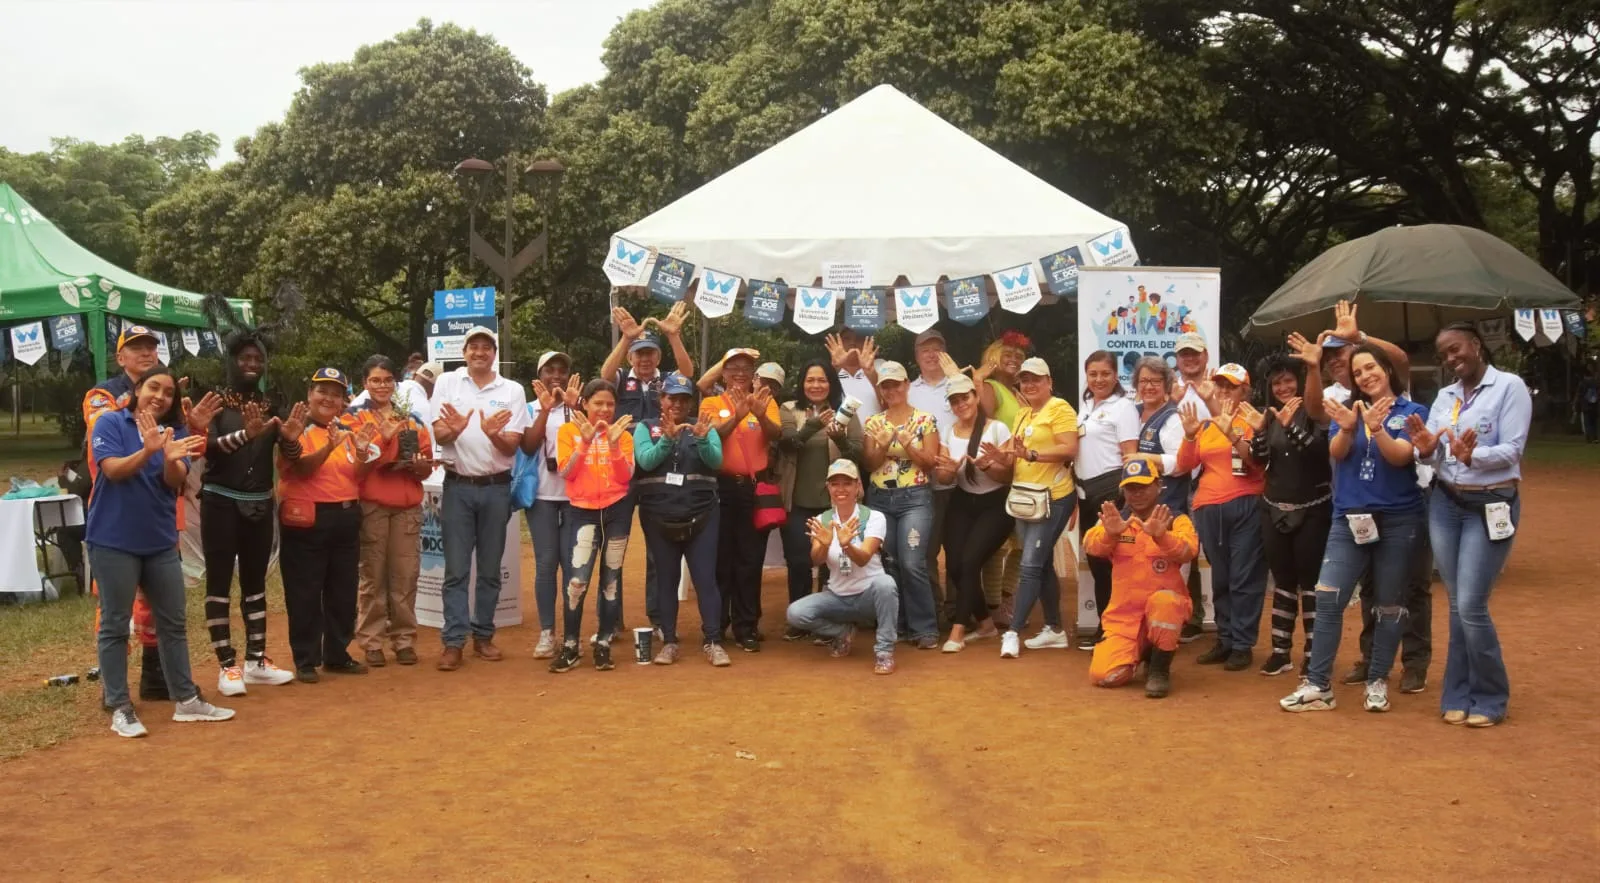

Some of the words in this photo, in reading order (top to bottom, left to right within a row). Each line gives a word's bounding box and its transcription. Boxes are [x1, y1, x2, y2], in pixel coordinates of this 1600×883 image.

[1106, 340, 1146, 349] CONTRA
[1148, 340, 1159, 349] EL
[1160, 340, 1177, 349] DEN
